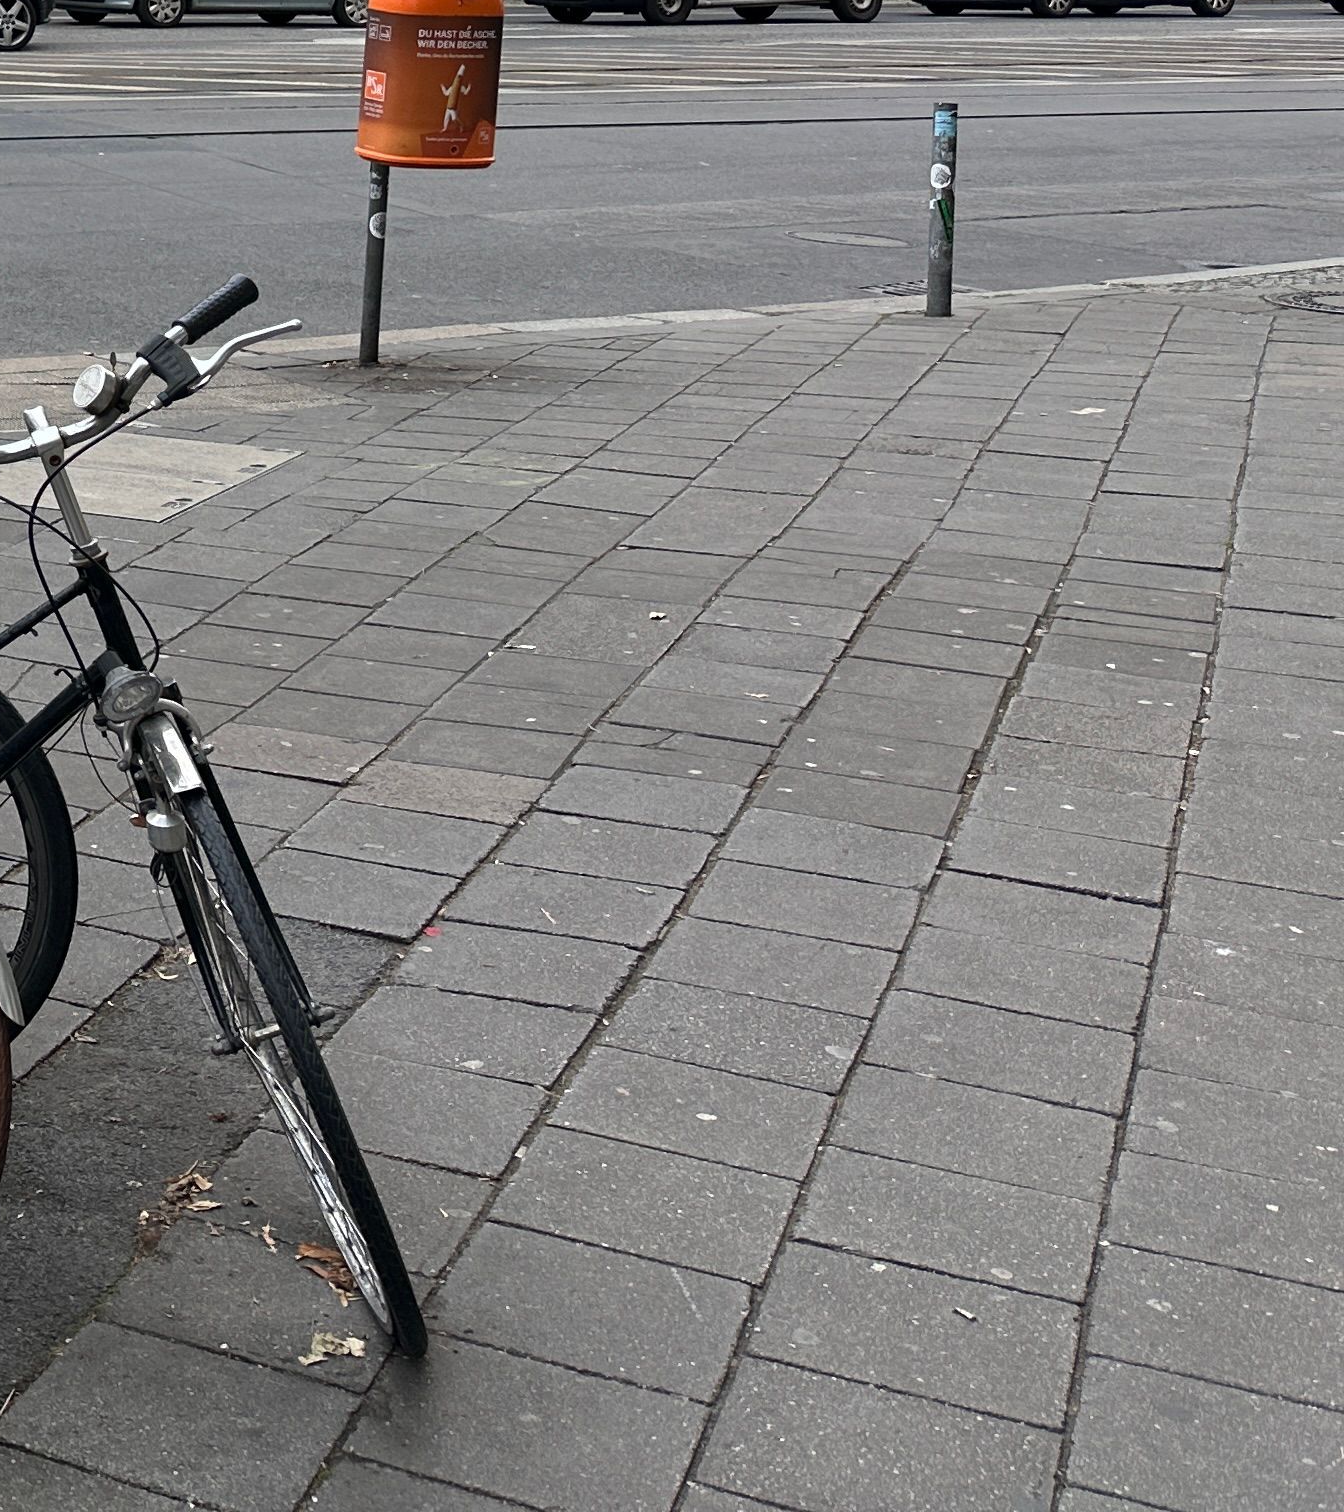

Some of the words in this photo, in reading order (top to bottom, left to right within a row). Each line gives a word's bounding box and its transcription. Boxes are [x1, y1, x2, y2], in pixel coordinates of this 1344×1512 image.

[418, 29, 433, 38] DU
[434, 29, 458, 39] HAST
[417, 39, 436, 48] WIR
[437, 40, 455, 49] DEN
